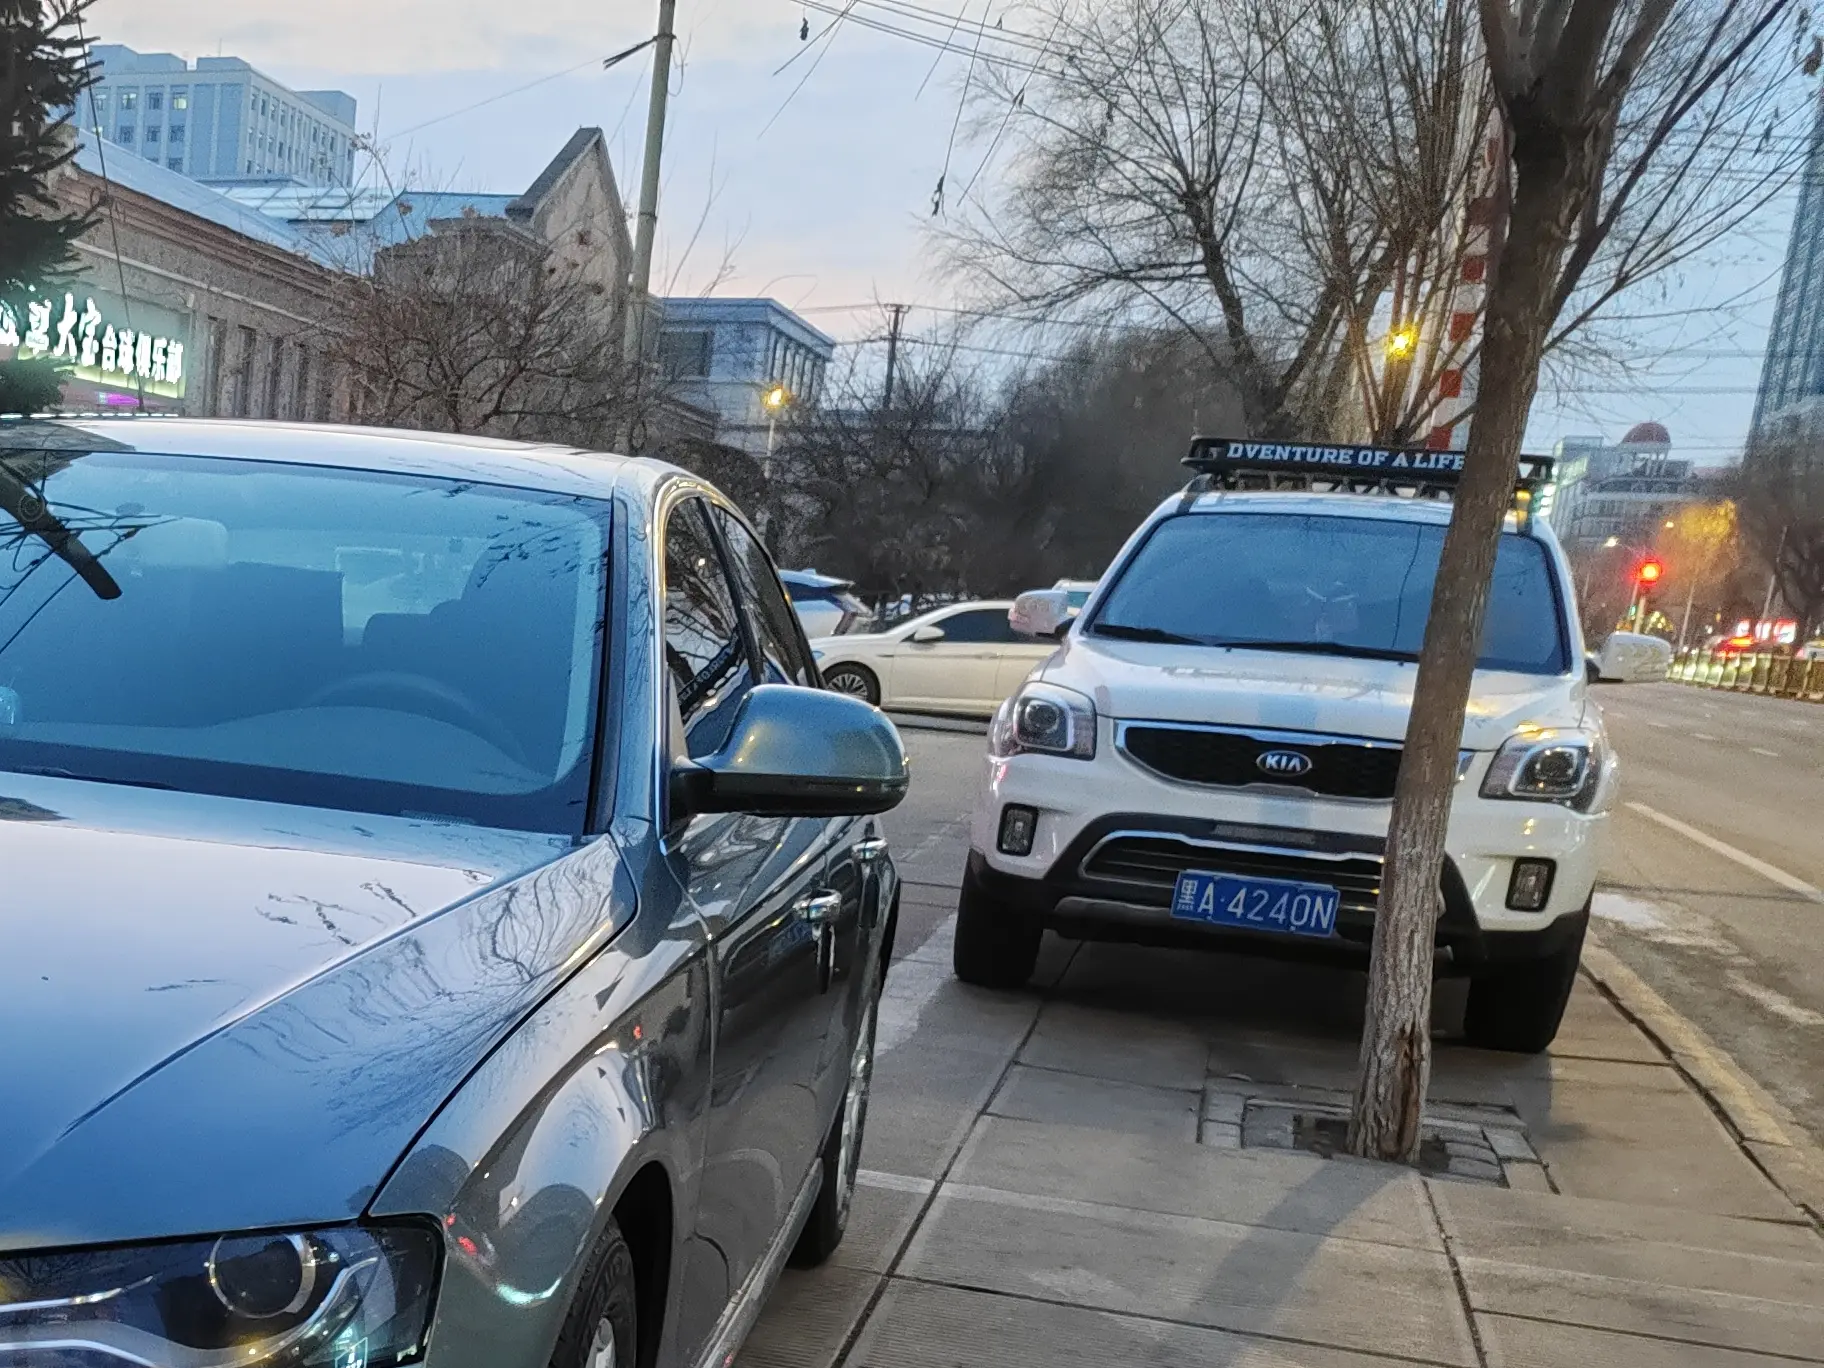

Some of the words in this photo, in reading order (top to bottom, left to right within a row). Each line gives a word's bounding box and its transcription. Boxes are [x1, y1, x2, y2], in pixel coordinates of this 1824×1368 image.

[1226, 443, 1351, 465] DVENTURE
[1357, 450, 1386, 467] OF
[1393, 452, 1411, 469] A
[1265, 754, 1302, 772] KIA
